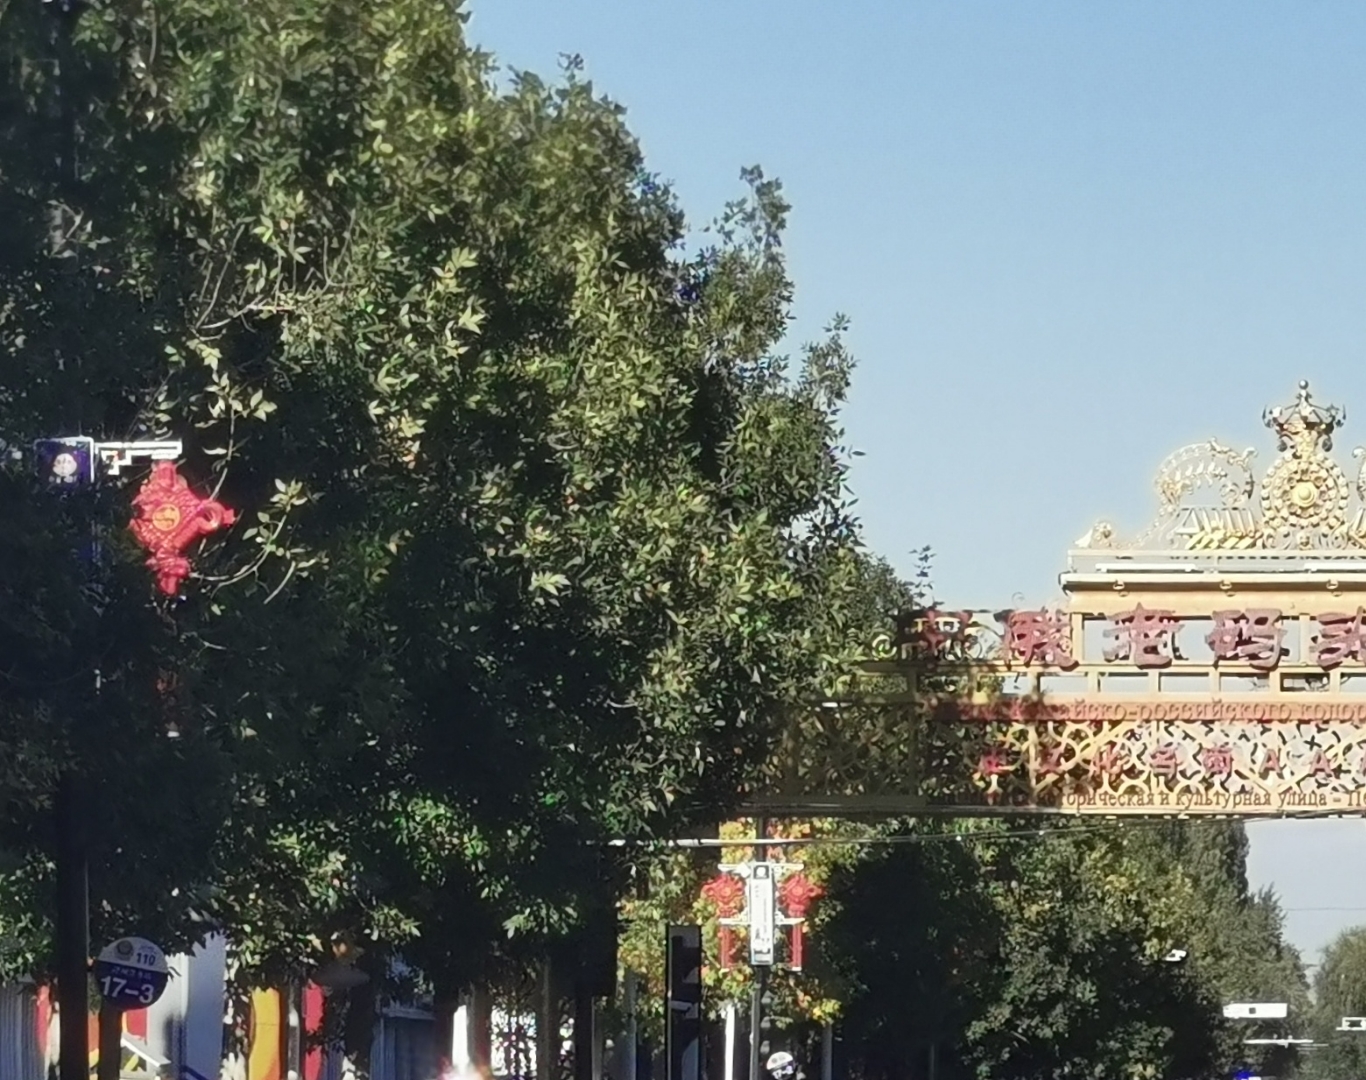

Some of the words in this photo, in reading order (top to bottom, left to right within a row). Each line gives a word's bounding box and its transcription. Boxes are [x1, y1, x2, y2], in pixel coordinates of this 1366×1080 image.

[1175, 792, 1271, 810] культурная
[1278, 792, 1327, 809] улица
[137, 952, 156, 967] 110
[100, 975, 154, 1004] 17-3
